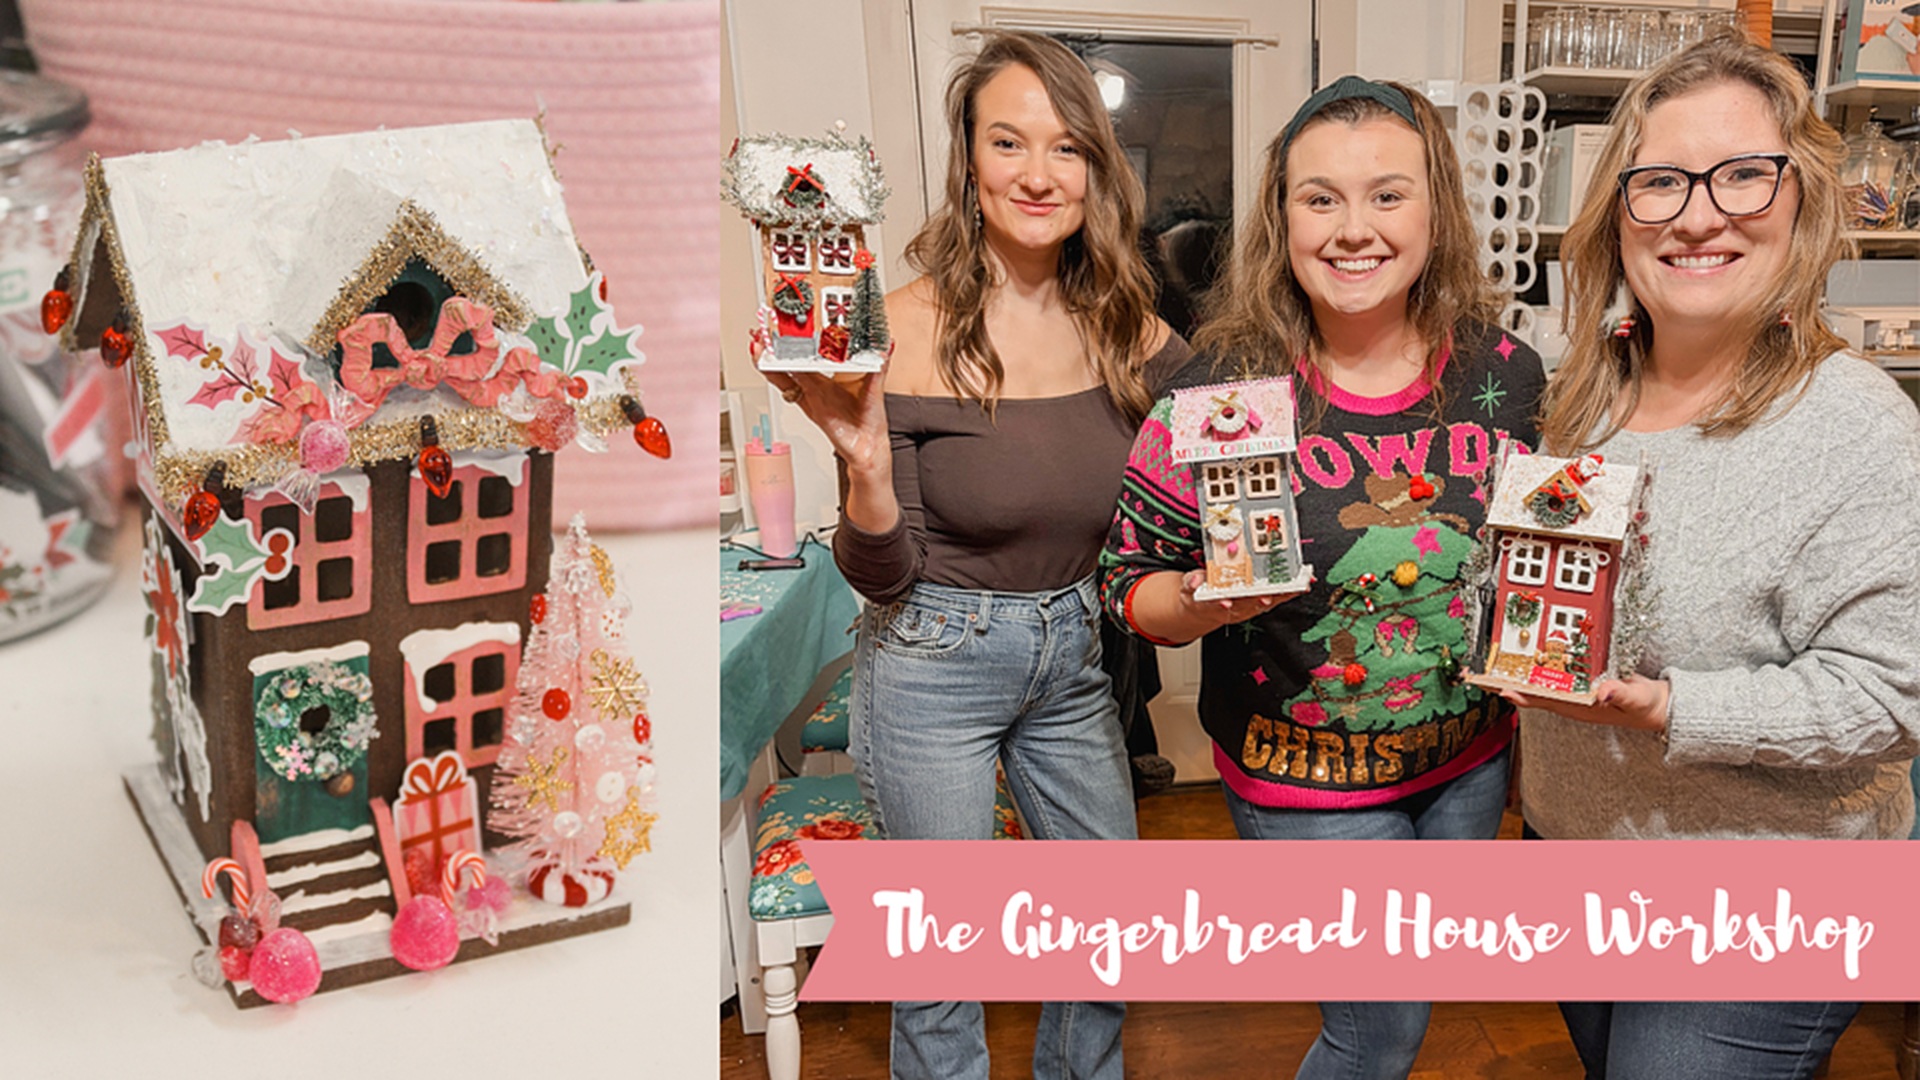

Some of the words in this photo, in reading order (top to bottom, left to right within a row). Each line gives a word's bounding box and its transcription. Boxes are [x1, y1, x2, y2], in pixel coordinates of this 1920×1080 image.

[1174, 445, 1216, 460] MERRY
[1219, 439, 1288, 456] CHRISTMAS
[1290, 420, 1532, 497] OWD
